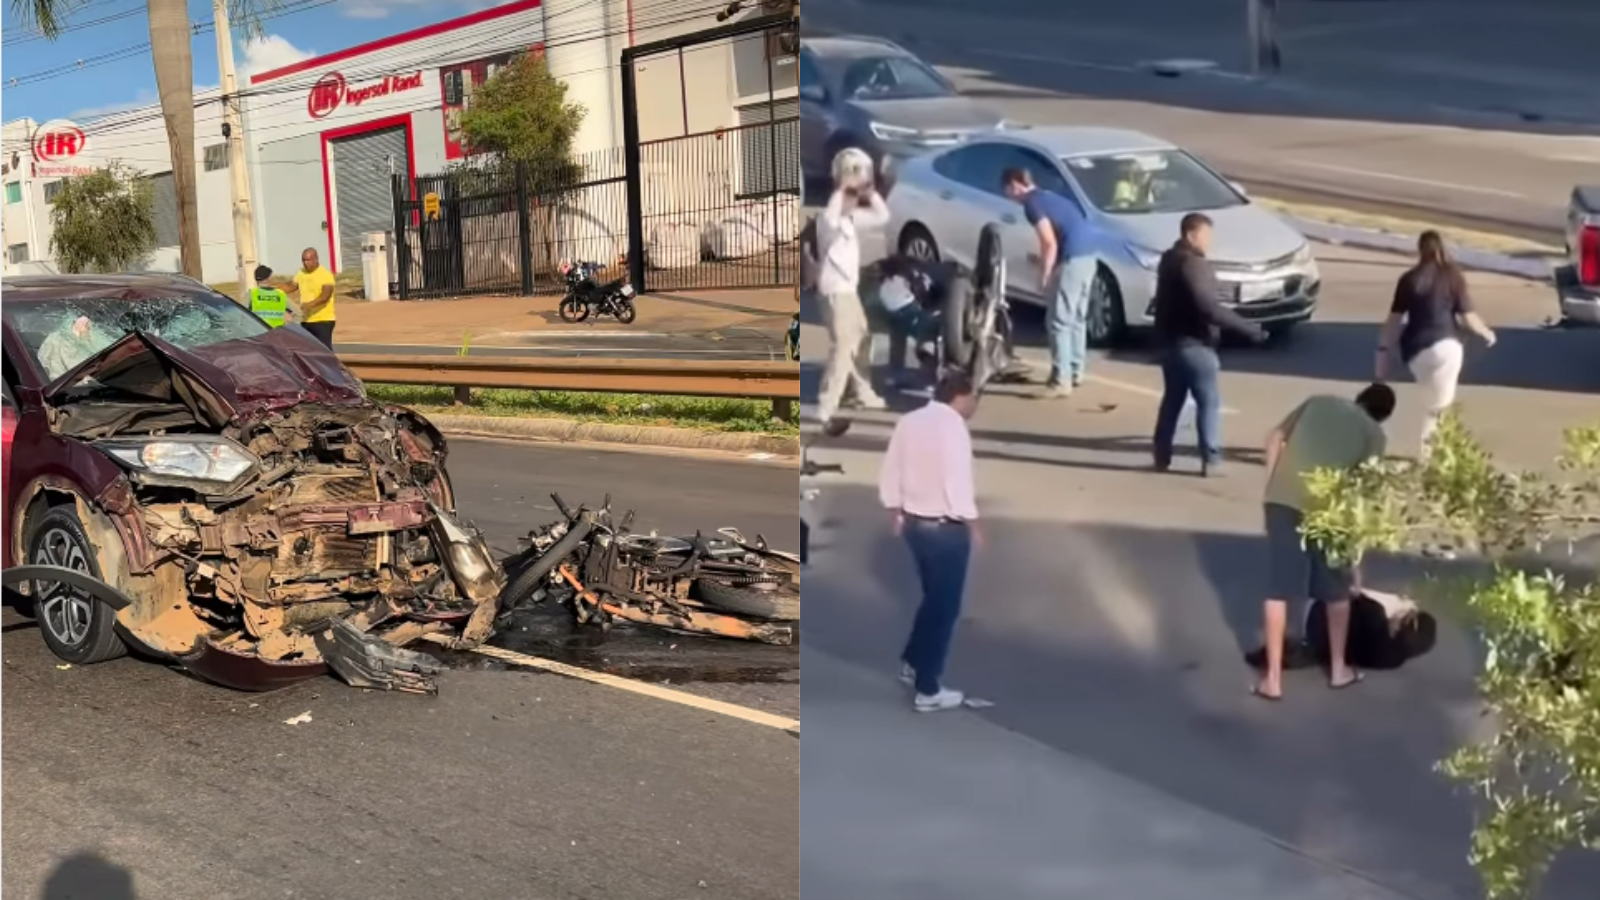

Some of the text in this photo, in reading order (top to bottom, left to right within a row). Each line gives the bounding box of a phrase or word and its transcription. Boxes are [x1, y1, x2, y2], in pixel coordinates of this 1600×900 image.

[314, 80, 339, 111] IR
[346, 77, 389, 106] Ingersoll
[45, 132, 77, 156] IR
